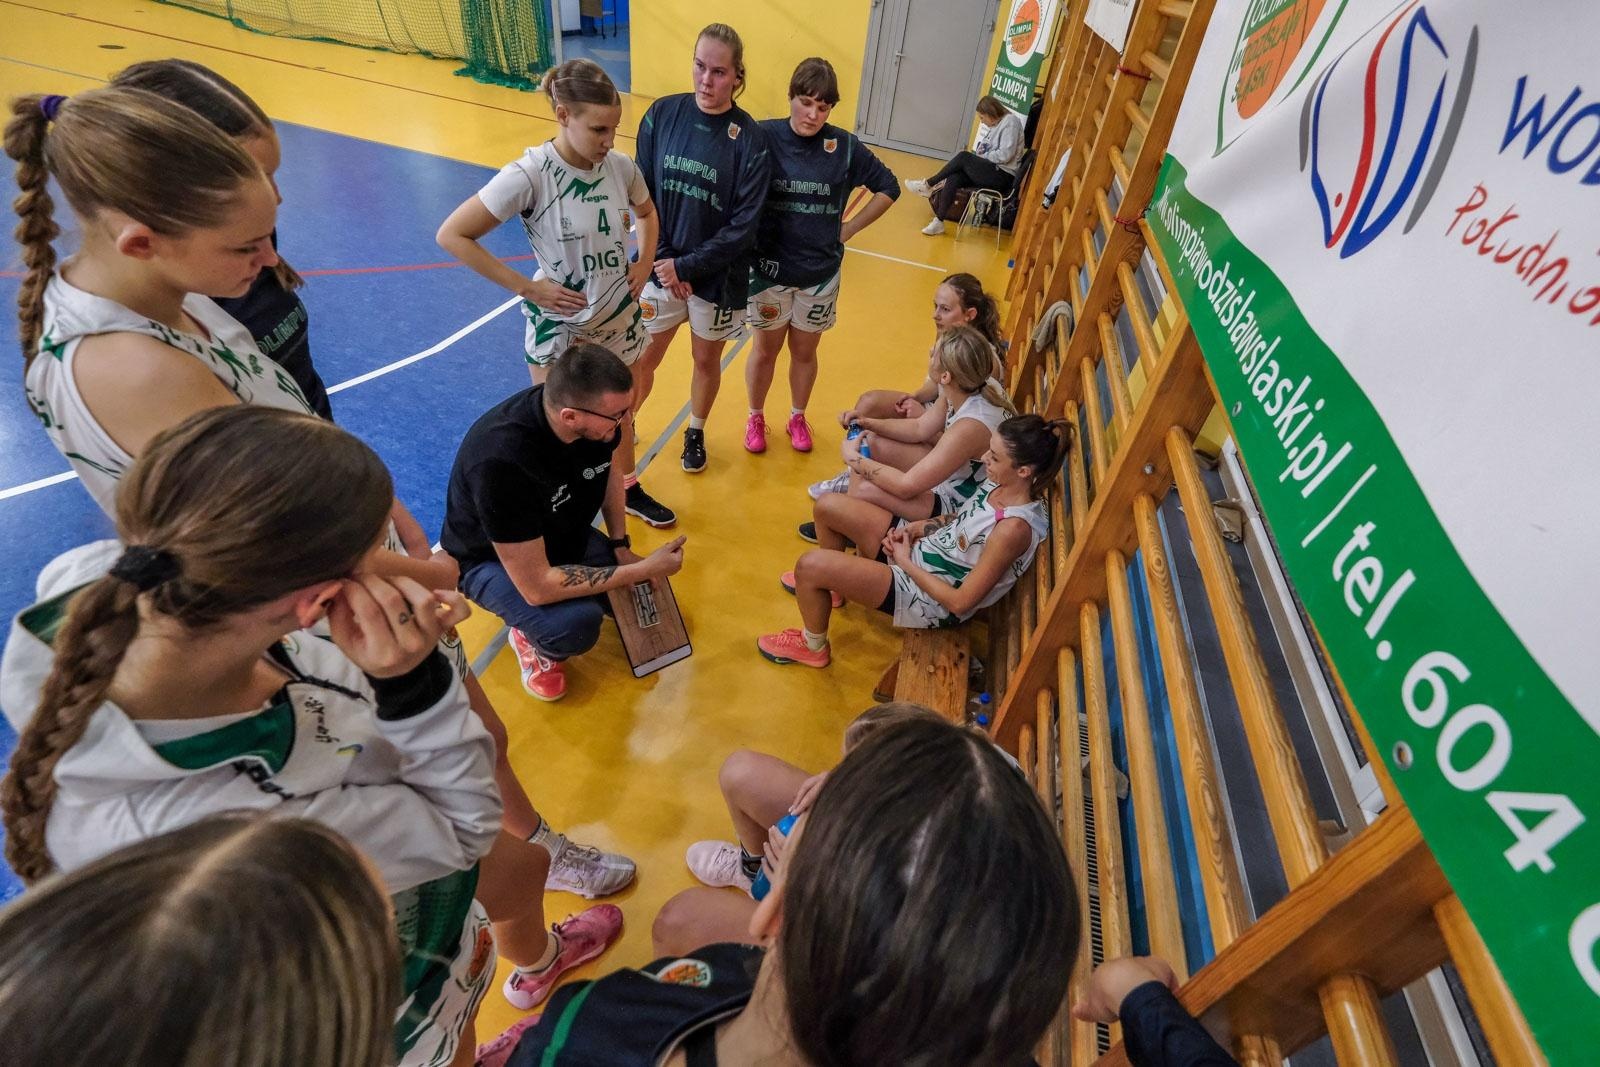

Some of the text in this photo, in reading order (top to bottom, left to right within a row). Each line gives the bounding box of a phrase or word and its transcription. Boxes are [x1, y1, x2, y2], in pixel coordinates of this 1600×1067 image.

[991, 73, 1028, 102] OLIMPIA
[1498, 74, 1600, 186] WO
[663, 154, 717, 184] OLIMPIA
[773, 179, 831, 196] OLIMPIA
[598, 208, 611, 236] 4
[582, 249, 619, 272] DIG
[1445, 180, 1600, 326] Południo
[806, 301, 833, 321] 24
[1332, 521, 1416, 661] tel.
[1401, 651, 1587, 874] 604
